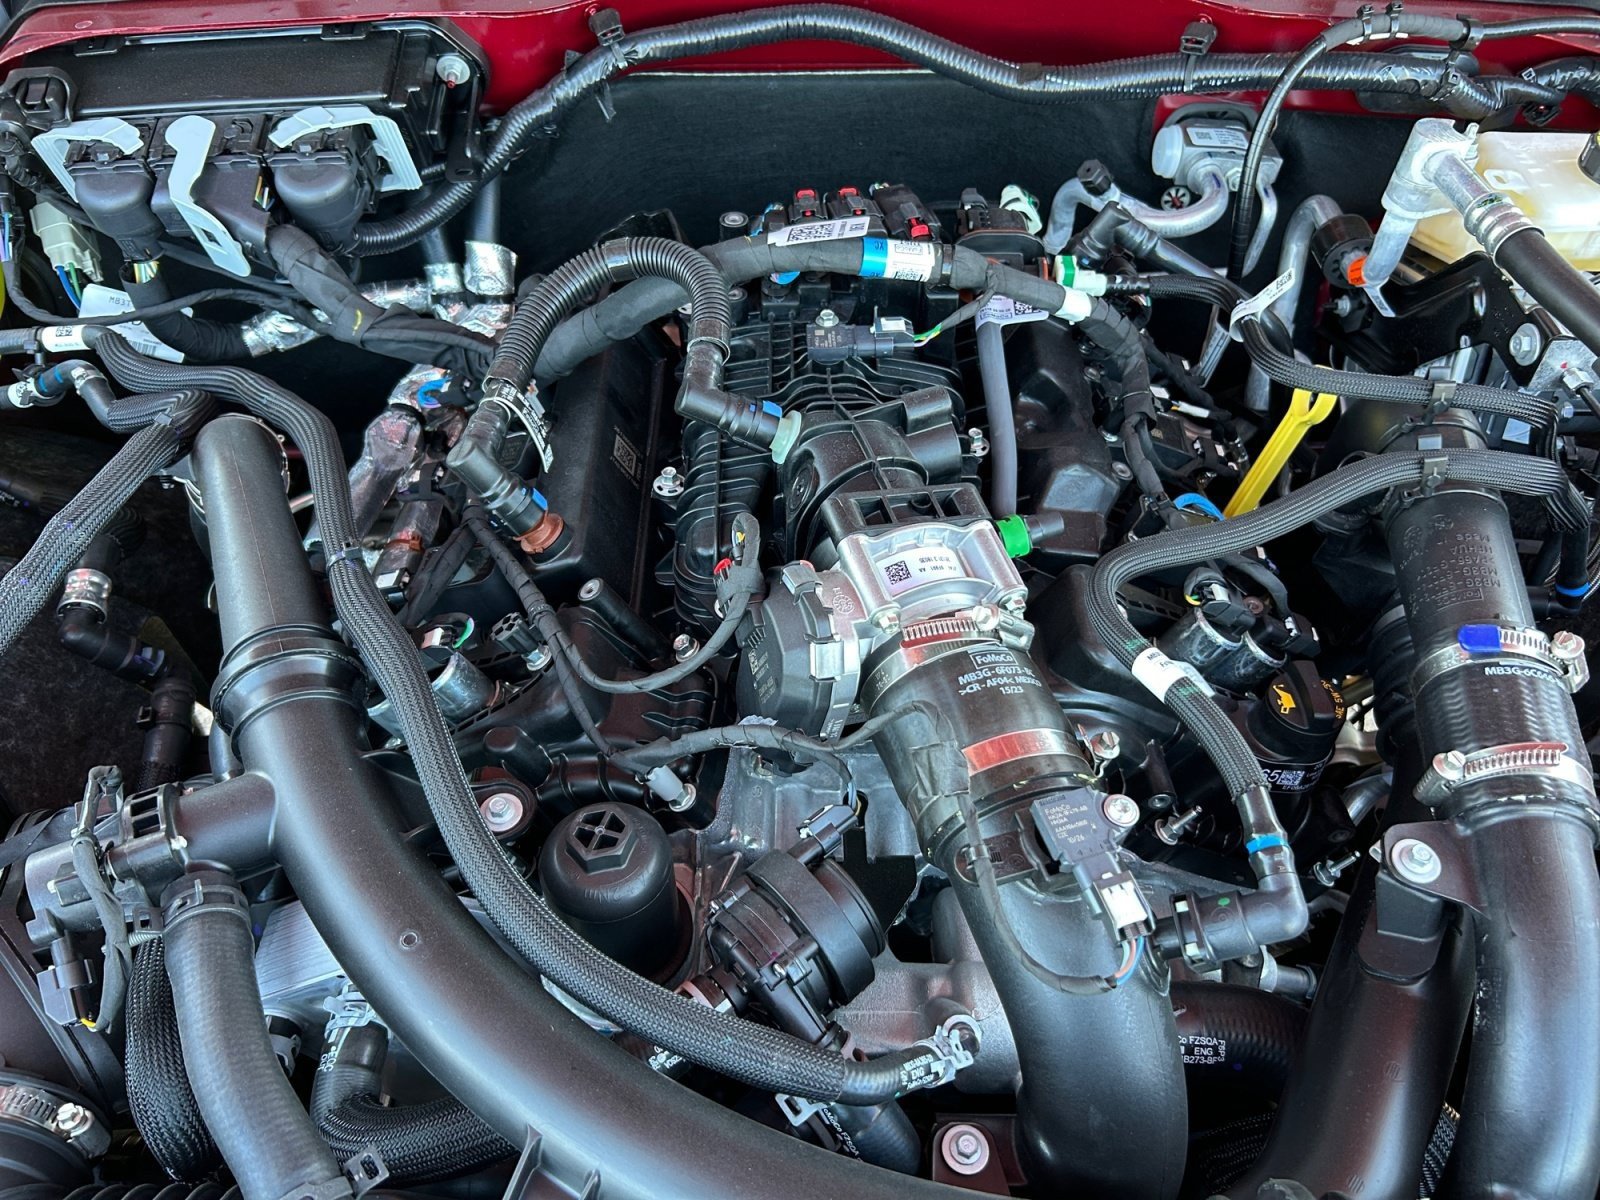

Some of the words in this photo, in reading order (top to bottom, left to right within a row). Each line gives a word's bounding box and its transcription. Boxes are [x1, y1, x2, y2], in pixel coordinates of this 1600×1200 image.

[975, 653, 1013, 665] FoMoCo
[1000, 685, 1024, 695] 15/23
[1189, 1036, 1218, 1046] FZSQA
[1194, 1047, 1213, 1056] ENG
[823, 1108, 843, 1132] oMoCo
